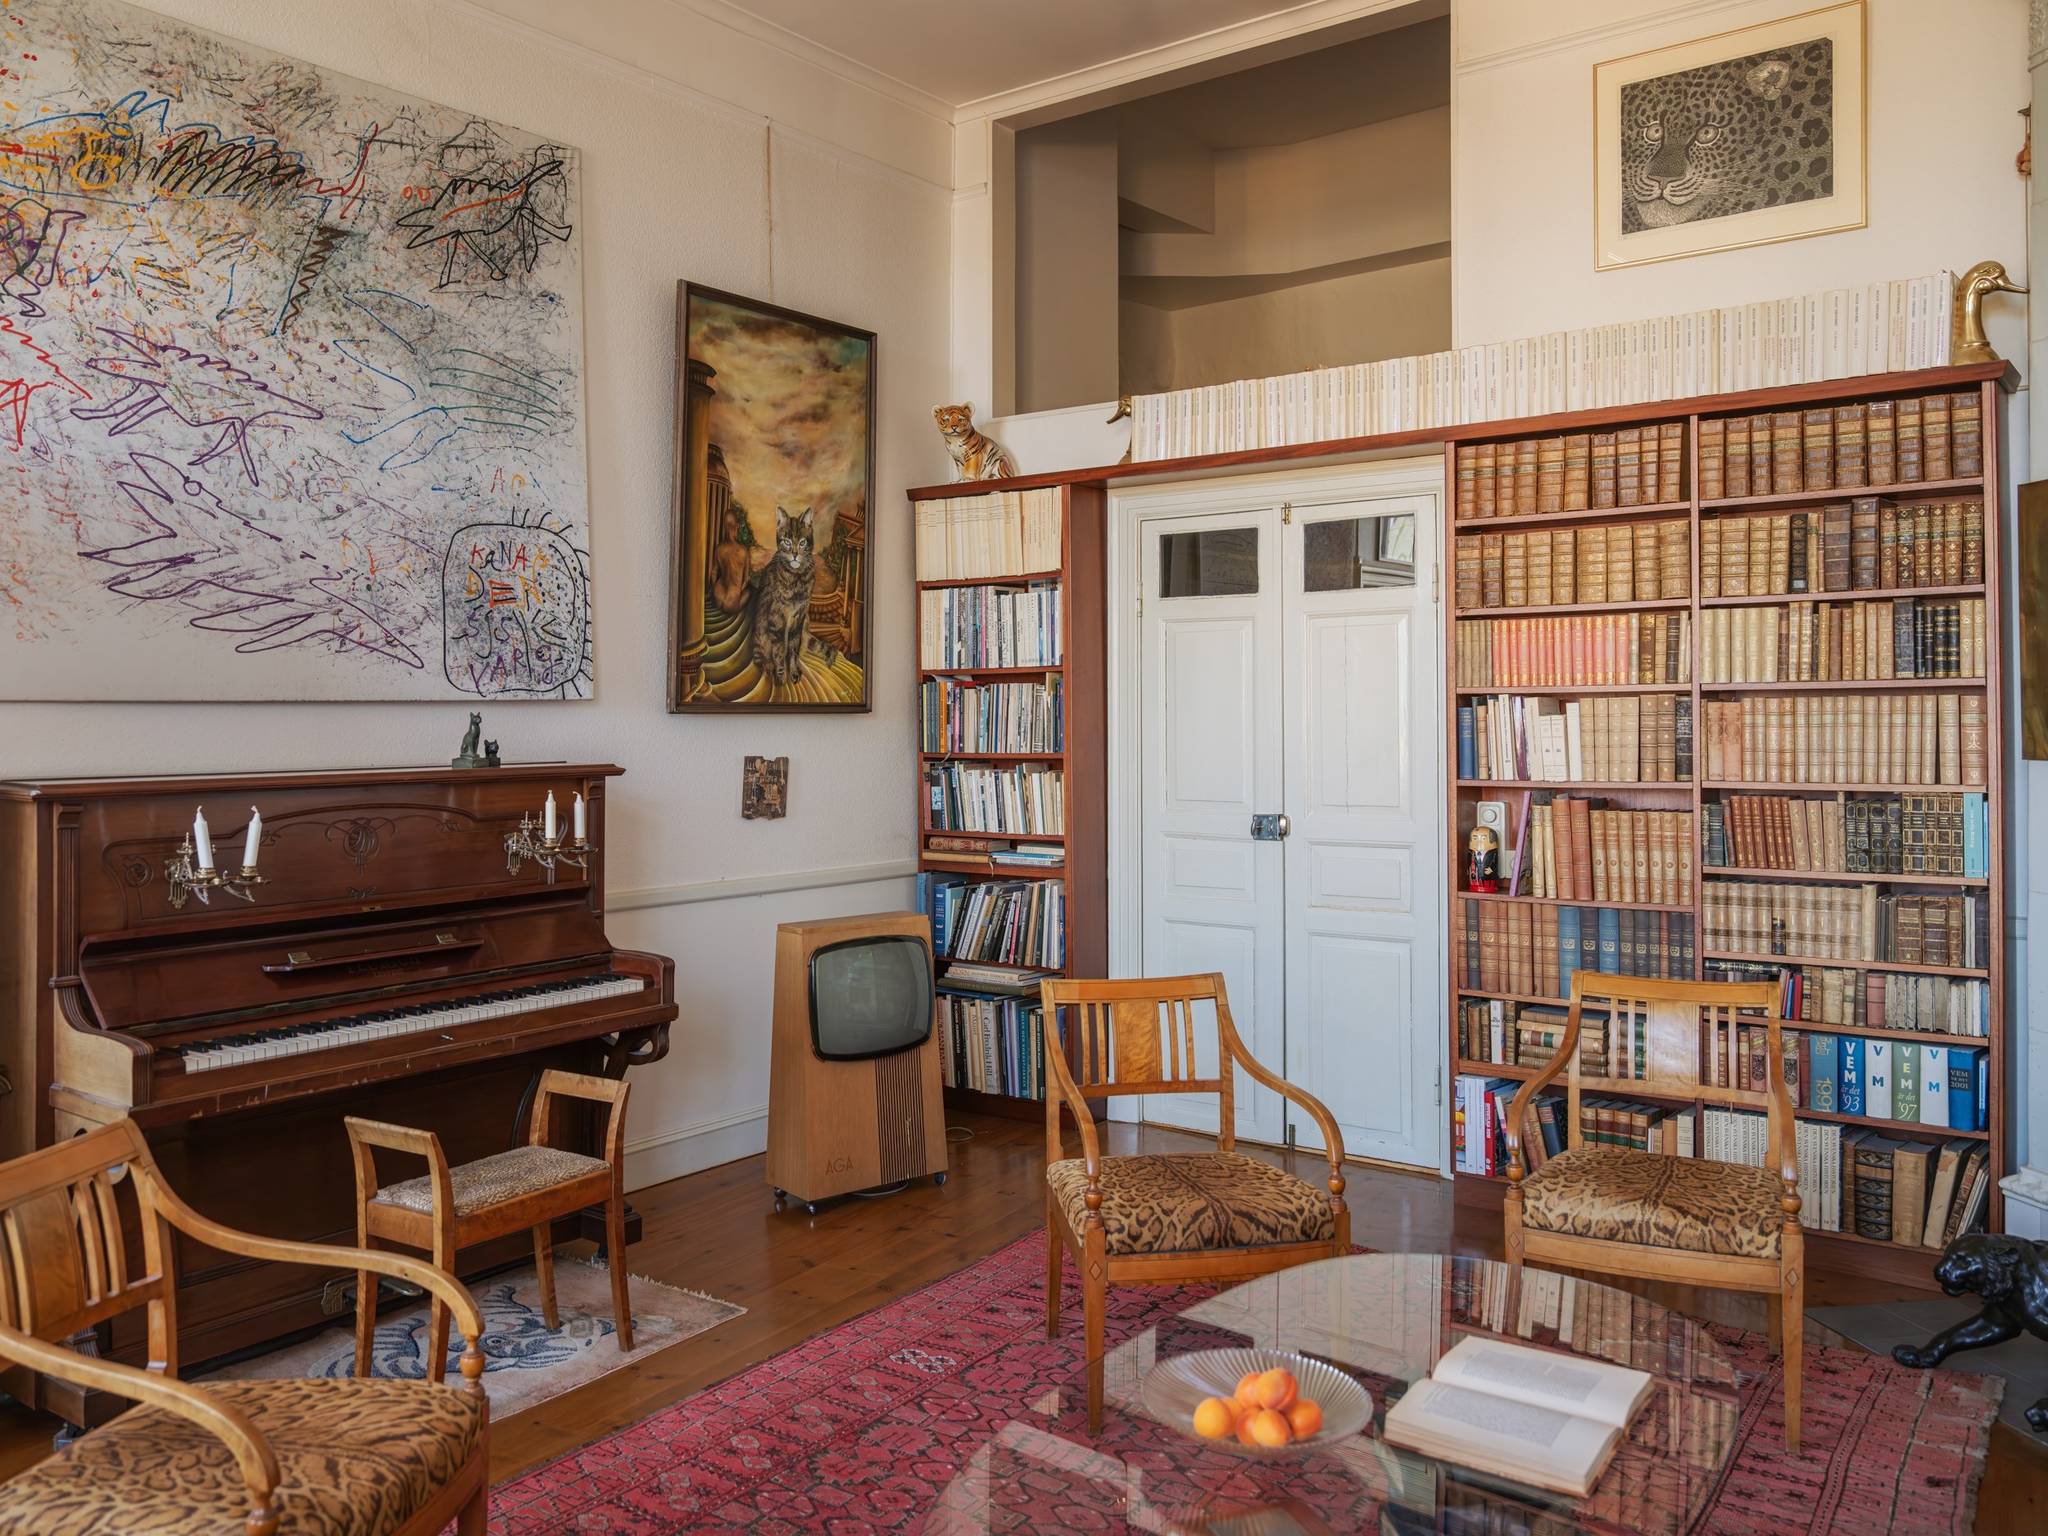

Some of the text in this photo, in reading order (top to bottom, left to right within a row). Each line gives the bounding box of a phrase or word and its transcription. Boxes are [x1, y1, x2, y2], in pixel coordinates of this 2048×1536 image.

[985, 1061, 993, 1076] Hill
[1844, 1041, 1856, 1084] VEM
[1901, 1046, 1913, 1090] VEM
[1950, 1069, 1968, 1078] VEM
[1849, 1085, 1861, 1096] det
[1950, 1081, 1968, 1089] 2001
[825, 1155, 854, 1176] AGA
